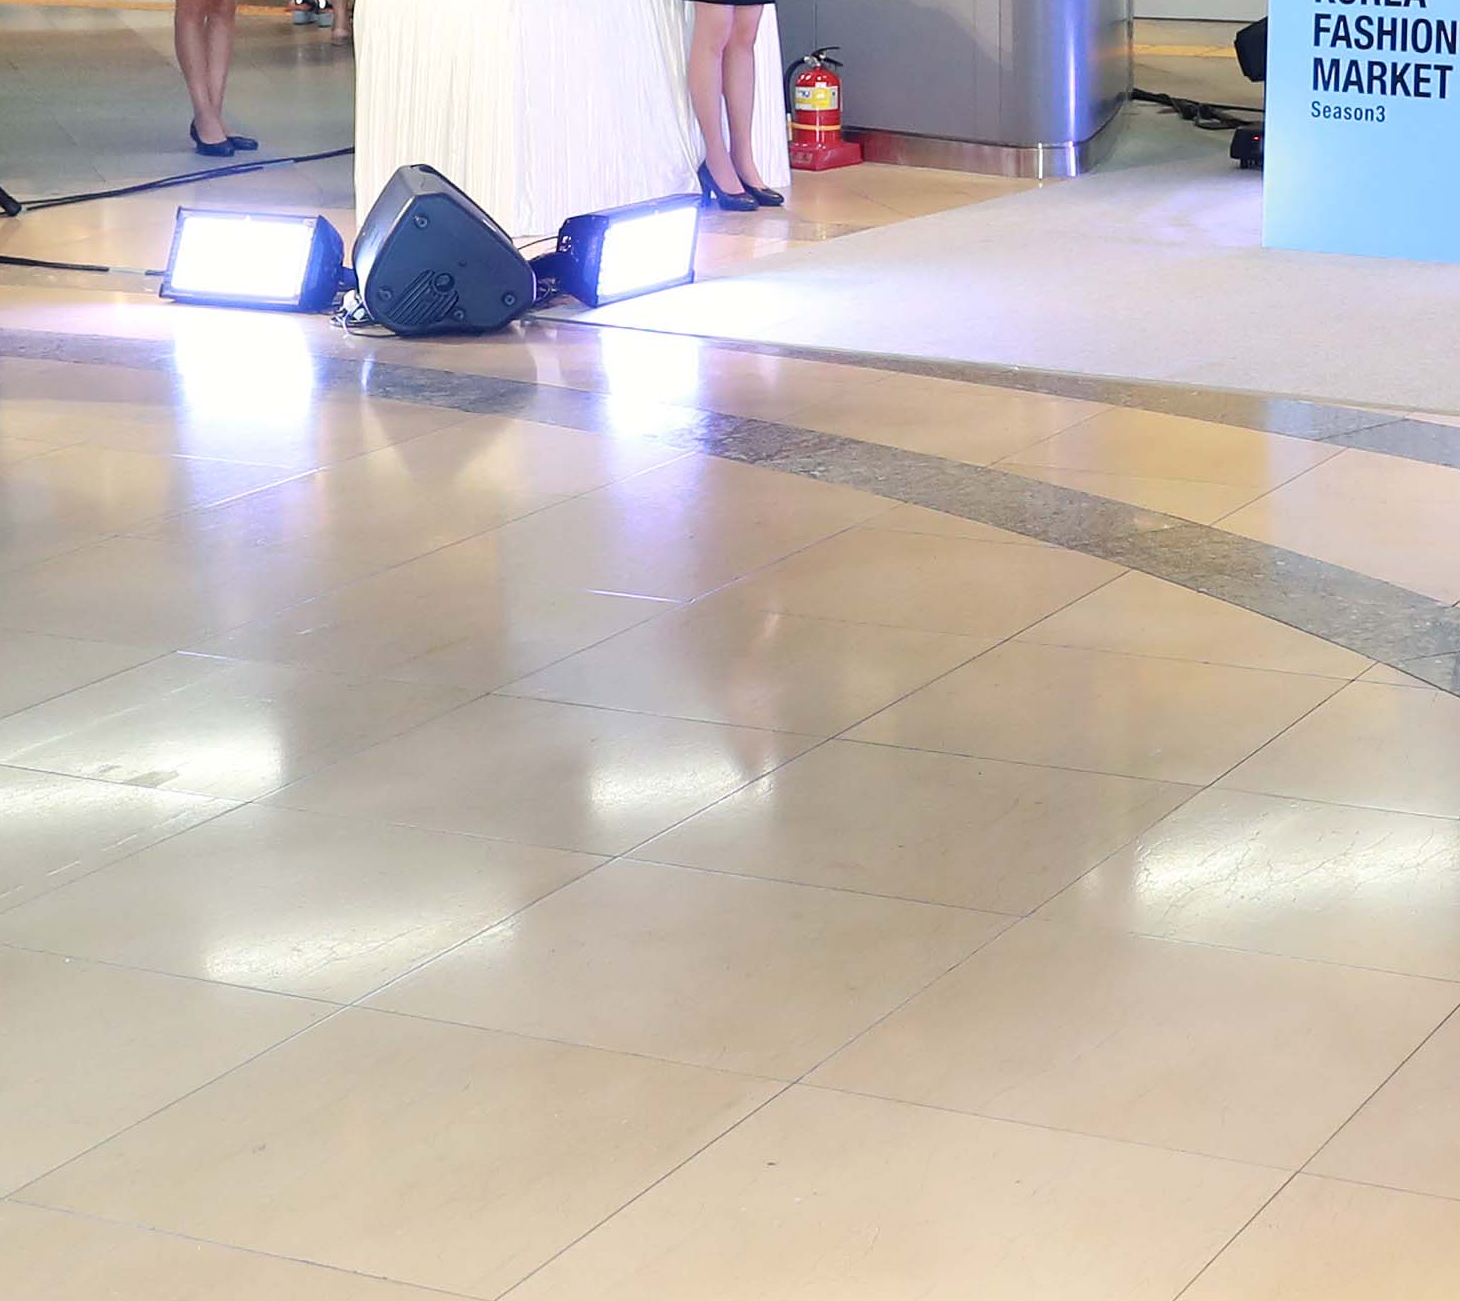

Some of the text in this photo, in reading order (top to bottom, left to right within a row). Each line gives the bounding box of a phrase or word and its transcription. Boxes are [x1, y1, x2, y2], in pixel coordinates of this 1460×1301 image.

[1313, 13, 1457, 55] FASHION
[1312, 57, 1453, 99] MARKET
[1311, 100, 1386, 123] Season3
